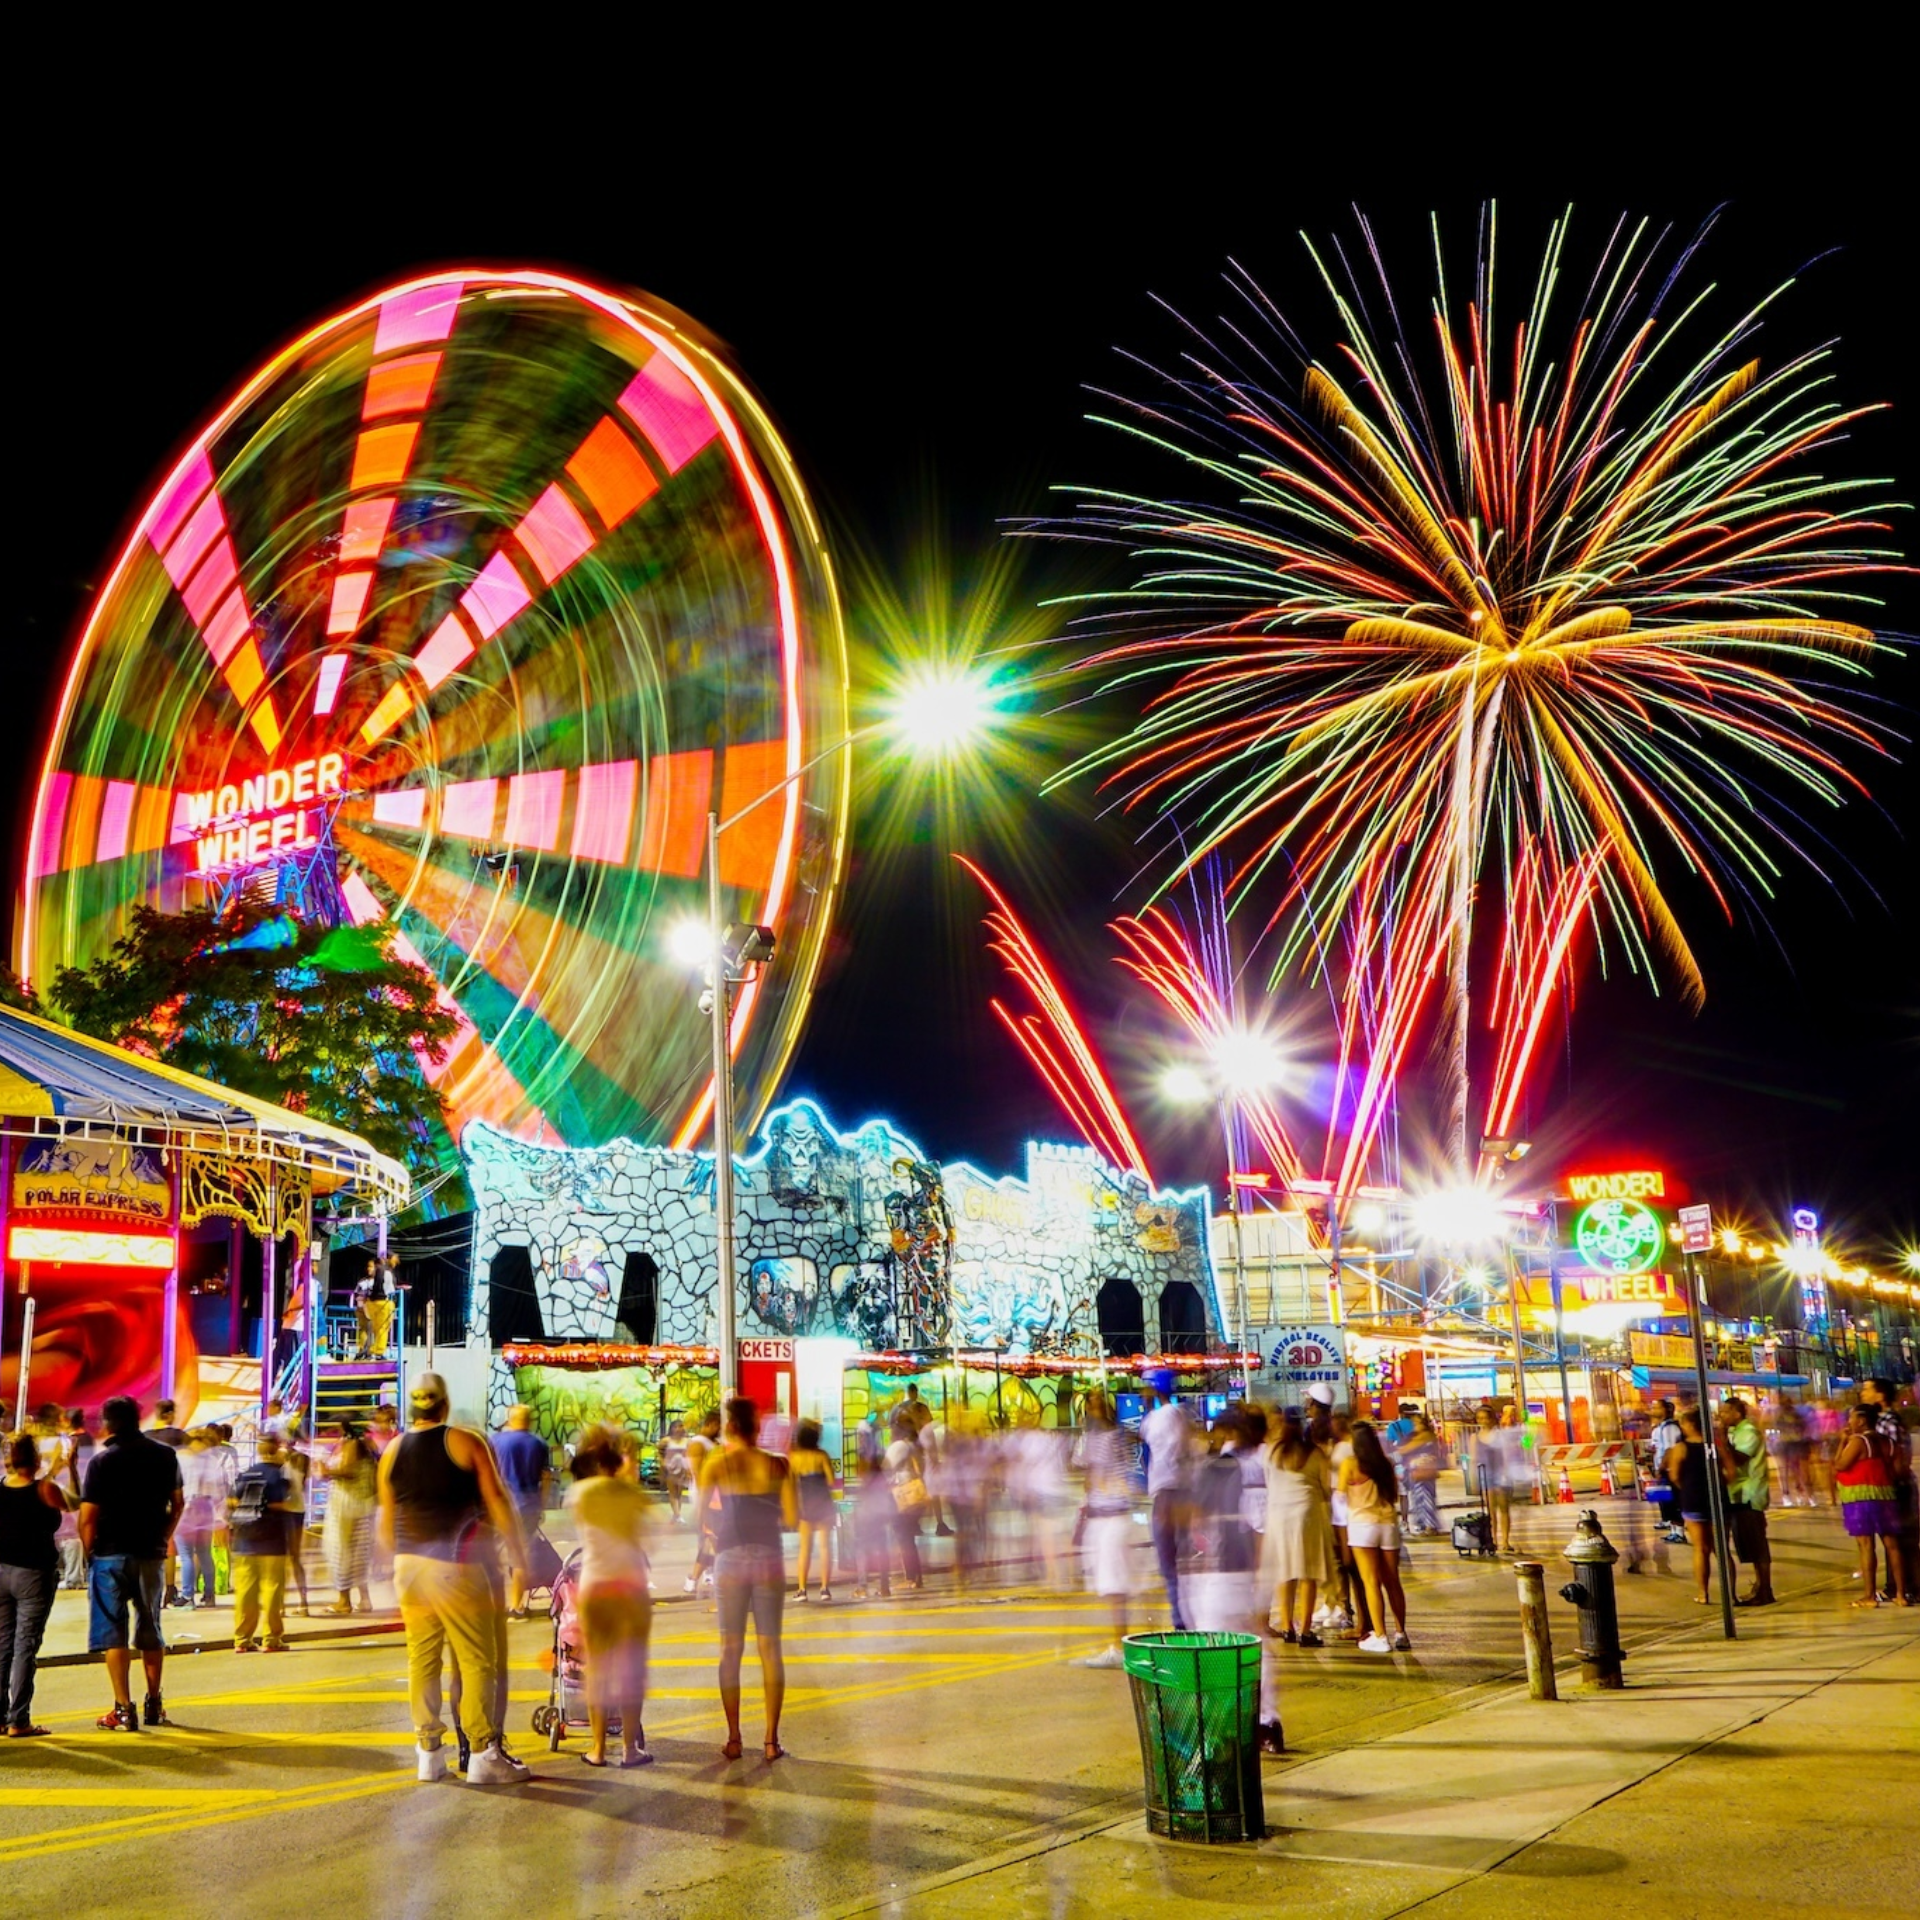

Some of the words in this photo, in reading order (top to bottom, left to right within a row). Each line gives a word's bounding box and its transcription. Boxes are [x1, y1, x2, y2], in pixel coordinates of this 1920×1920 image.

[188, 752, 344, 831] WONDER
[197, 809, 317, 875] WHEEL
[1569, 1171, 1658, 1200] WONDER
[25, 1187, 81, 1206] POLAR
[85, 1189, 164, 1217] EXPRESS
[1582, 1274, 1667, 1300] WHEEL
[737, 1341, 792, 1358] ICKETS
[1288, 1345, 1322, 1367] 3D
